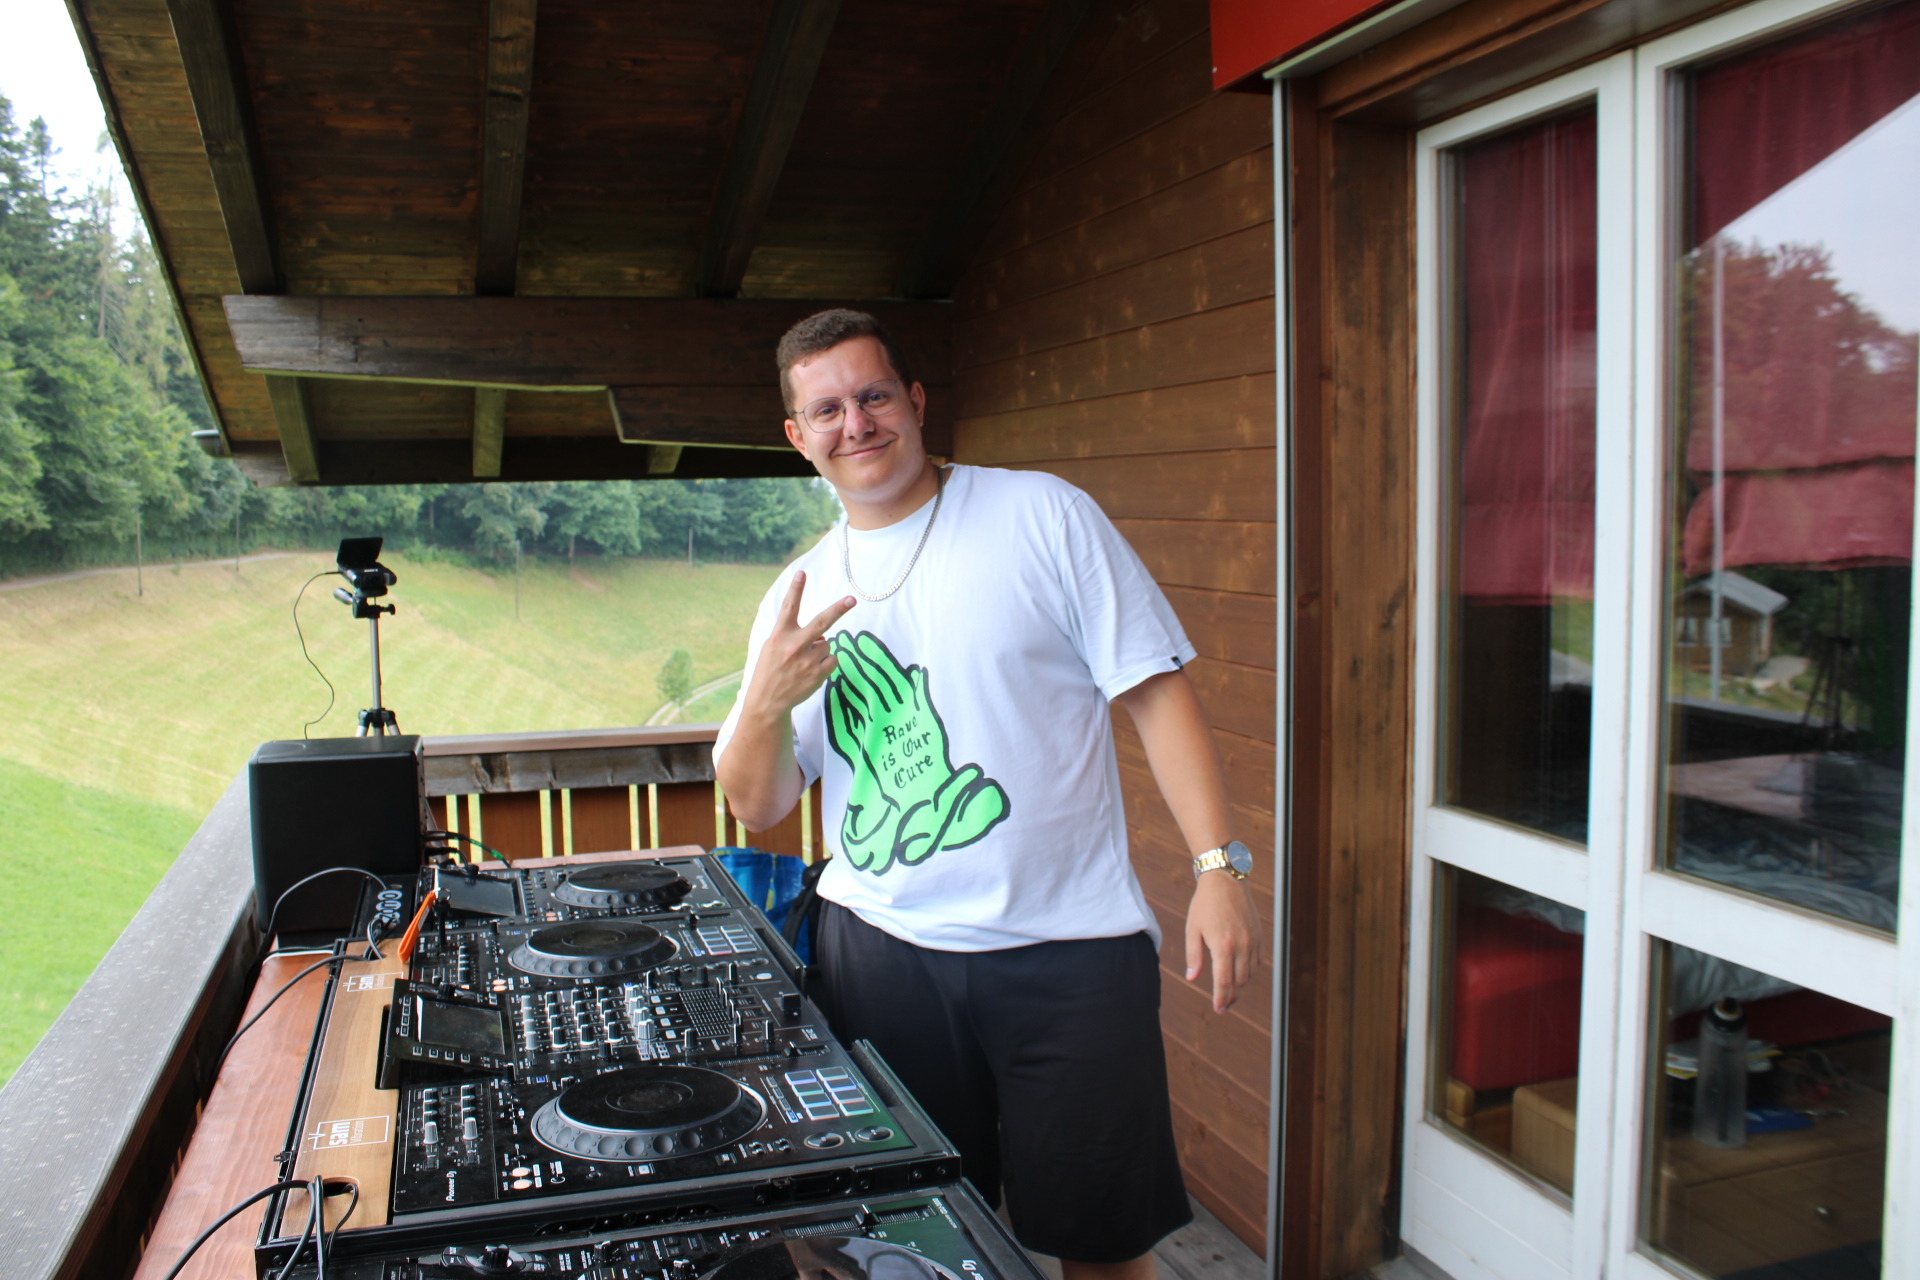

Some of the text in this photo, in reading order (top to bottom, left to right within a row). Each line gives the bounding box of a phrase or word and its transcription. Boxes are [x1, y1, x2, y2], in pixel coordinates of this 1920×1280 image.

[882, 715, 918, 745] Rave
[881, 731, 931, 772] is Our
[894, 755, 934, 789] Cure
[328, 1121, 350, 1146] sam
[445, 1178, 455, 1202] Pioneer
